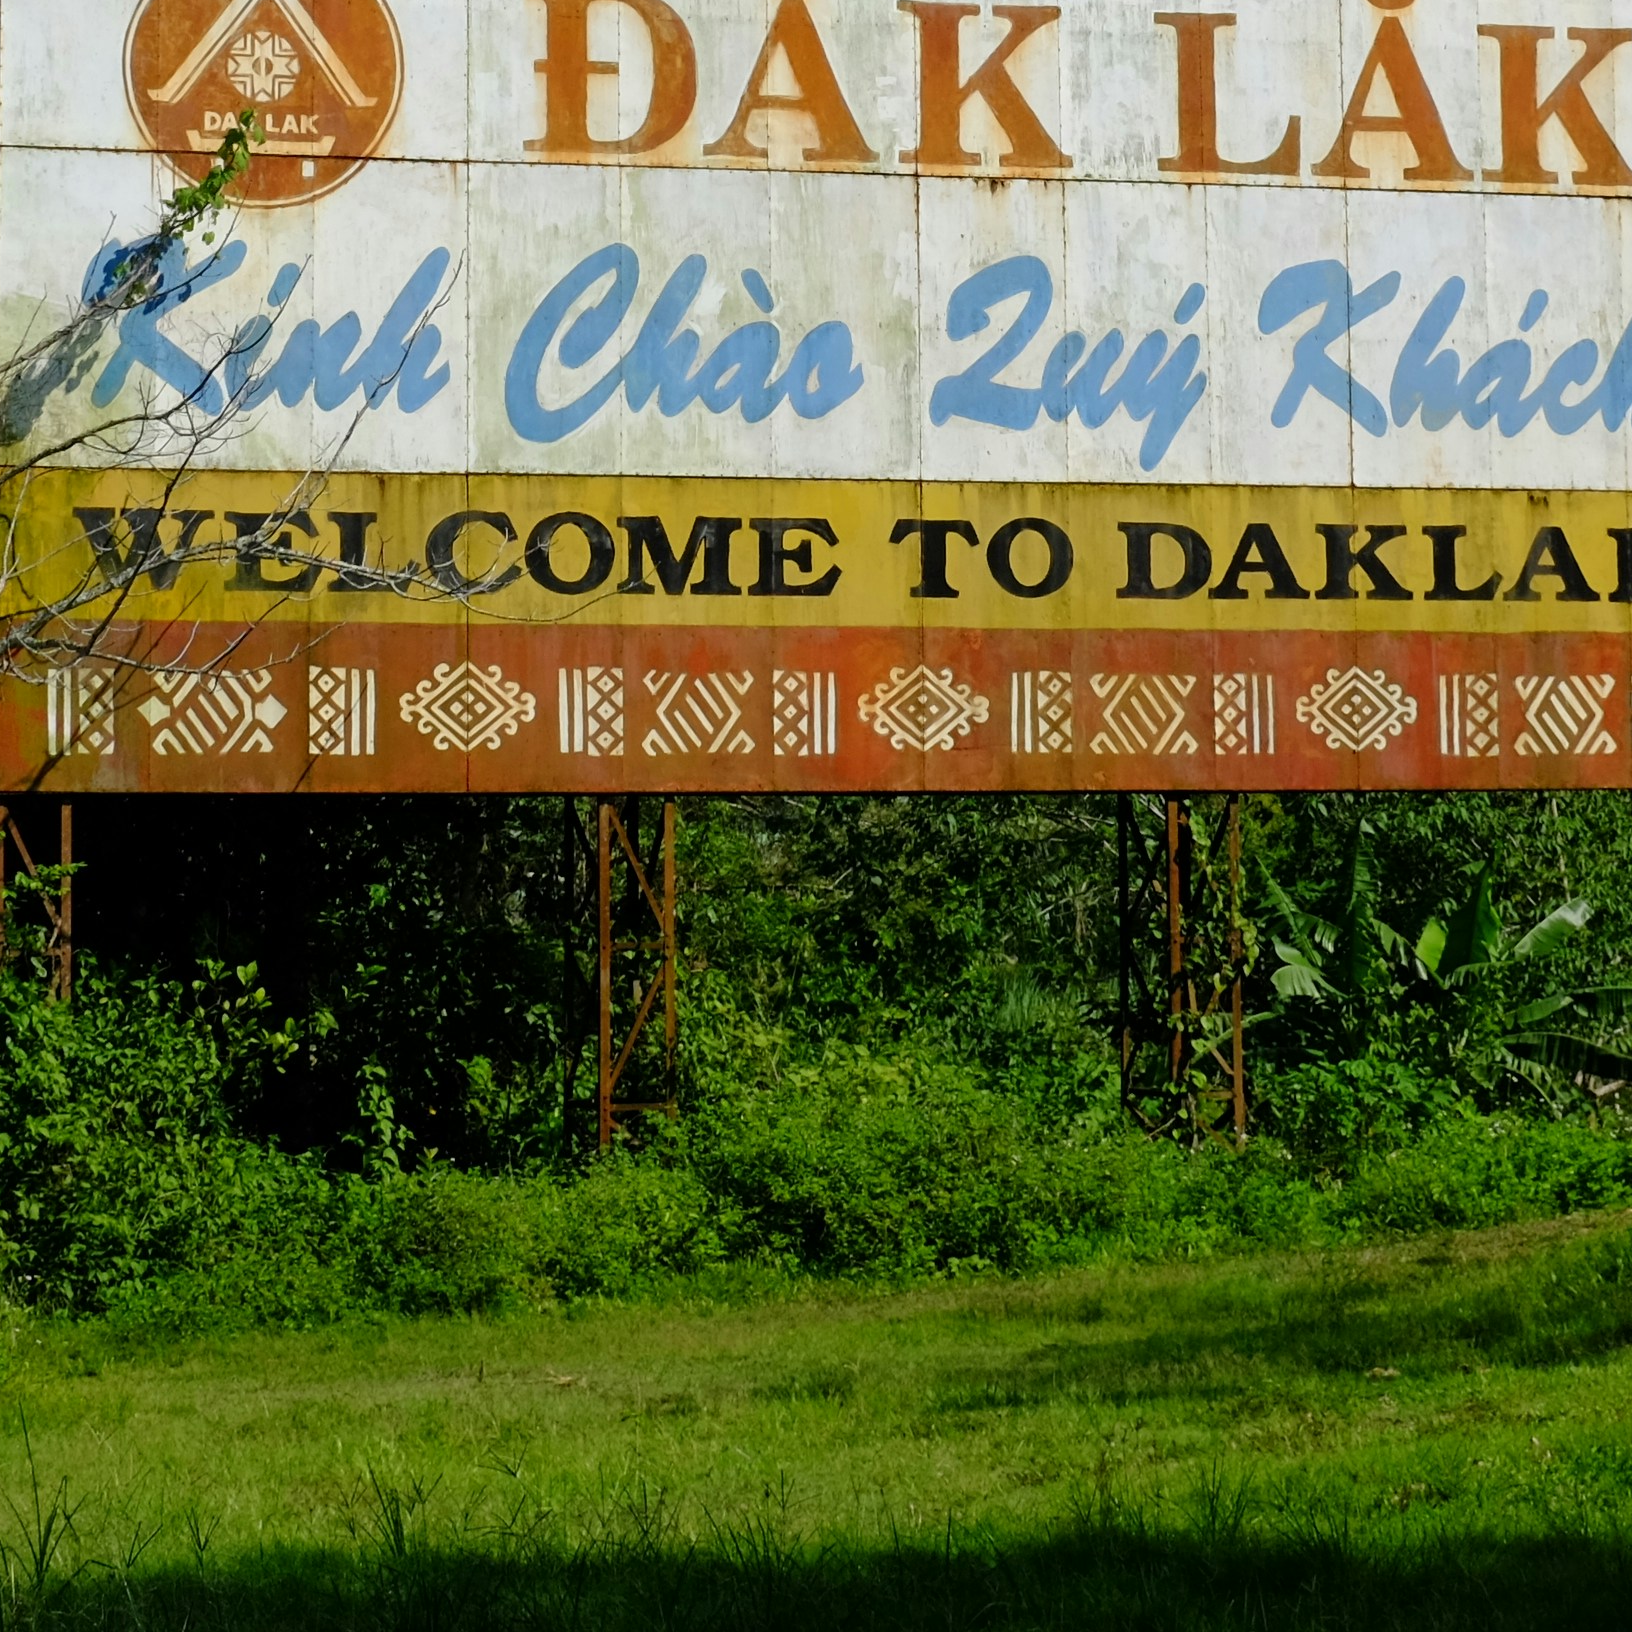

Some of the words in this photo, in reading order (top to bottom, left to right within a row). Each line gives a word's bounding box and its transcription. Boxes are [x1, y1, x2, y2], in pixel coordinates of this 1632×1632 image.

[265, 113, 320, 135] LAK
[504, 242, 864, 444] Chào
[929, 255, 1208, 472] Quý
[72, 506, 843, 598] WELCOME
[888, 517, 1075, 600] TO
